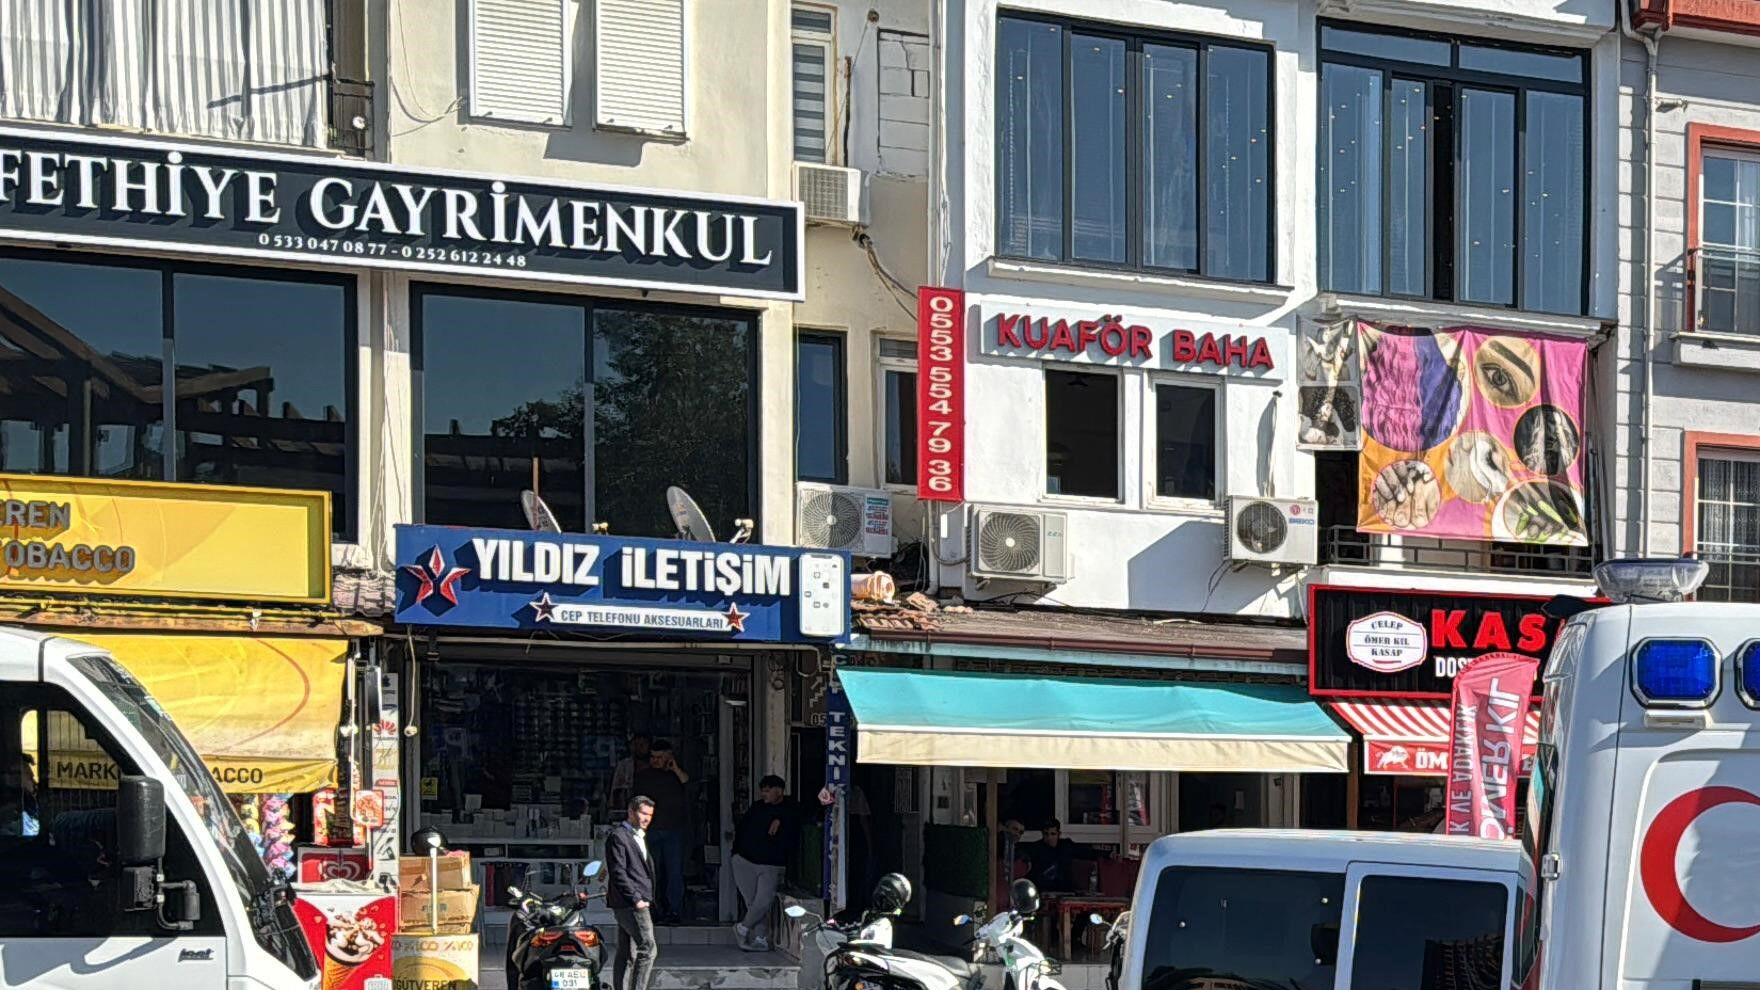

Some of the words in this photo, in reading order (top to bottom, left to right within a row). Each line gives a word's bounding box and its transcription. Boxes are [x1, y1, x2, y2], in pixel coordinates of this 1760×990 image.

[0, 150, 282, 225] FETHİYE
[309, 177, 773, 266] GAYRİMENKUL
[258, 233, 270, 245] 0
[273, 235, 302, 249] 533
[308, 238, 338, 251] 047
[343, 241, 364, 254] 08
[368, 243, 387, 256] 77
[402, 245, 412, 258] 0
[415, 247, 447, 261] 252
[450, 249, 478, 263] 612
[483, 252, 502, 265] 24
[506, 254, 527, 268] 48
[998, 312, 1153, 359] KUAFÖR
[1172, 328, 1275, 370] BAHA
[0, 540, 136, 574] OBACCO
[472, 538, 600, 586] YILDIZ
[561, 610, 583, 622] CEP
[587, 611, 641, 625] TELEFONU
[644, 614, 724, 631] AKSESUARLARI
[1431, 609, 1557, 652] KAS
[1371, 648, 1403, 657] KASAP
[57, 760, 121, 781] MARK
